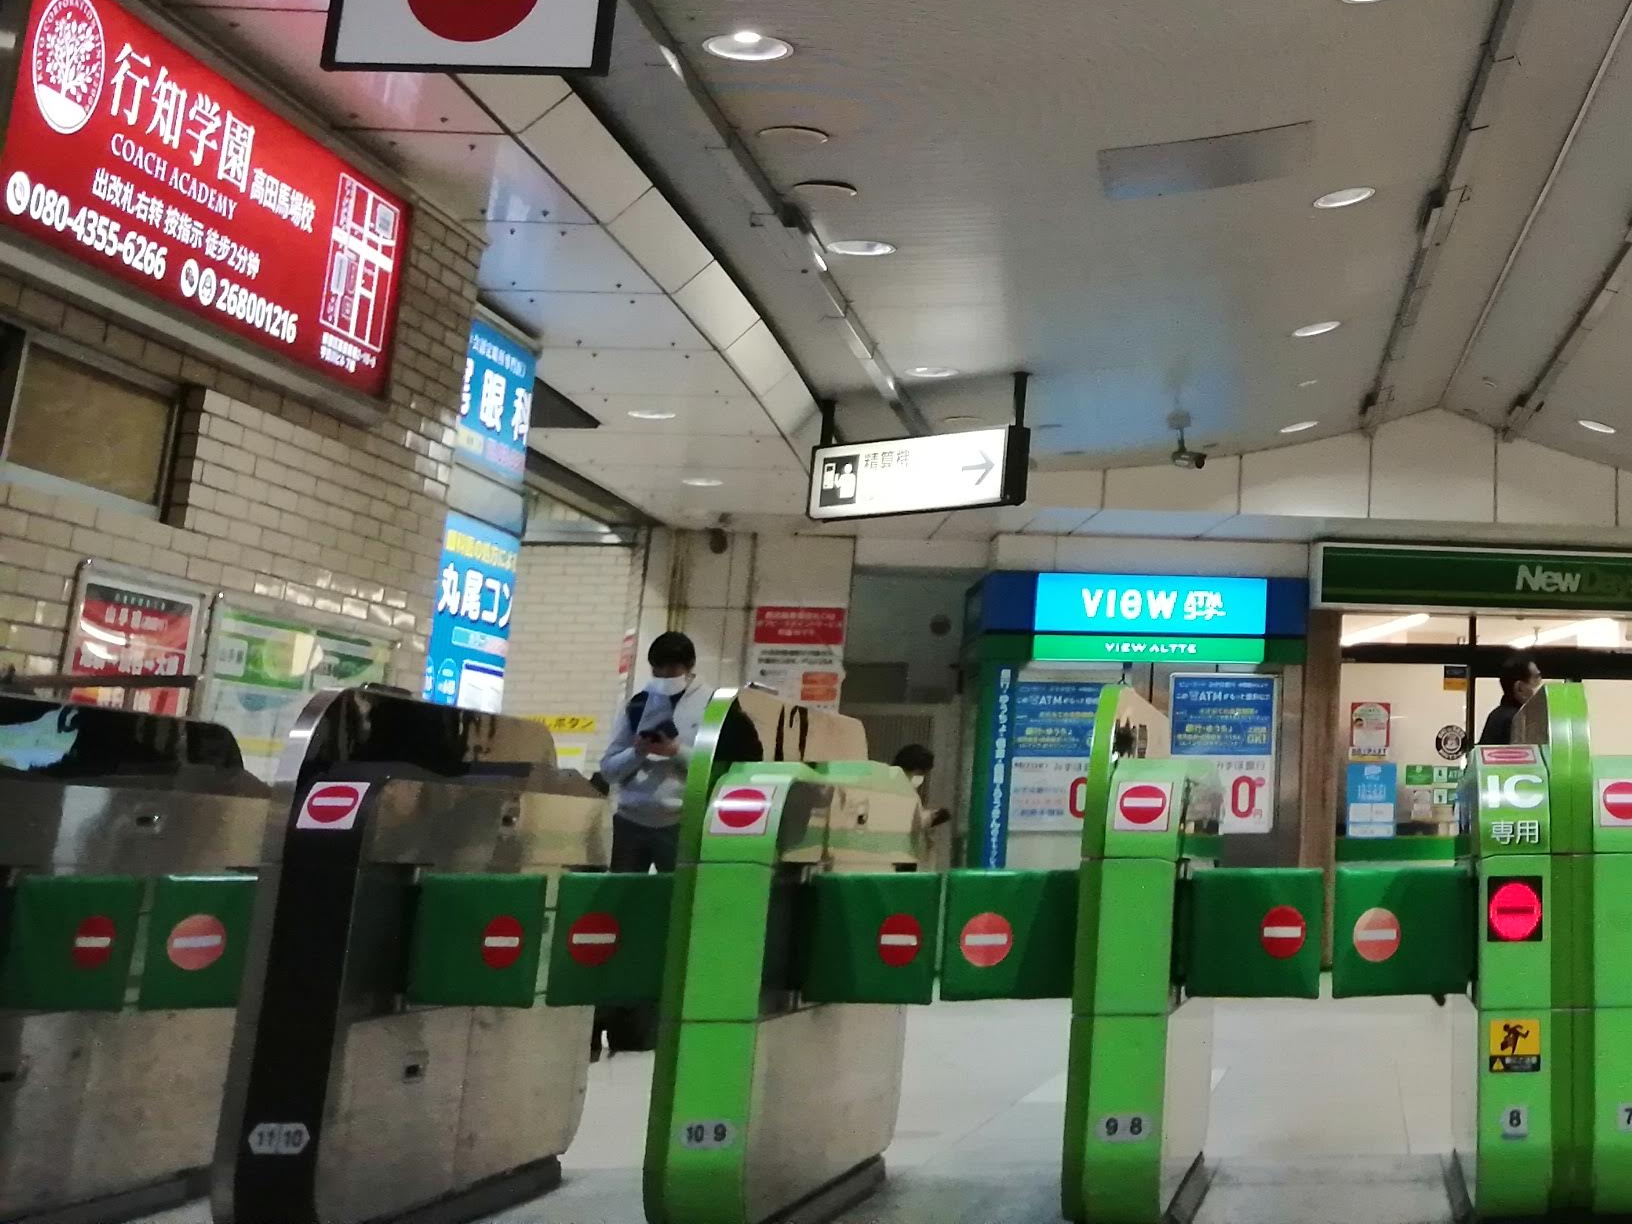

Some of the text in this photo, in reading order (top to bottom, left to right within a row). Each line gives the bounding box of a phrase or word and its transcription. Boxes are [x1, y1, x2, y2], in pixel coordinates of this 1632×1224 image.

[110, 42, 255, 194] 行知学園
[110, 132, 238, 220] COACH ACADEMY
[29, 183, 168, 281] 080-4355-6266
[215, 279, 298, 345] 268001216
[1104, 642, 1197, 654] VIEW ALTTE
[1487, 774, 1544, 809] IC
[1490, 820, 1541, 846] 専用
[713, 1123, 727, 1142] 9
[1105, 1117, 1143, 1136] 9 8
[1508, 1109, 1522, 1128] 8
